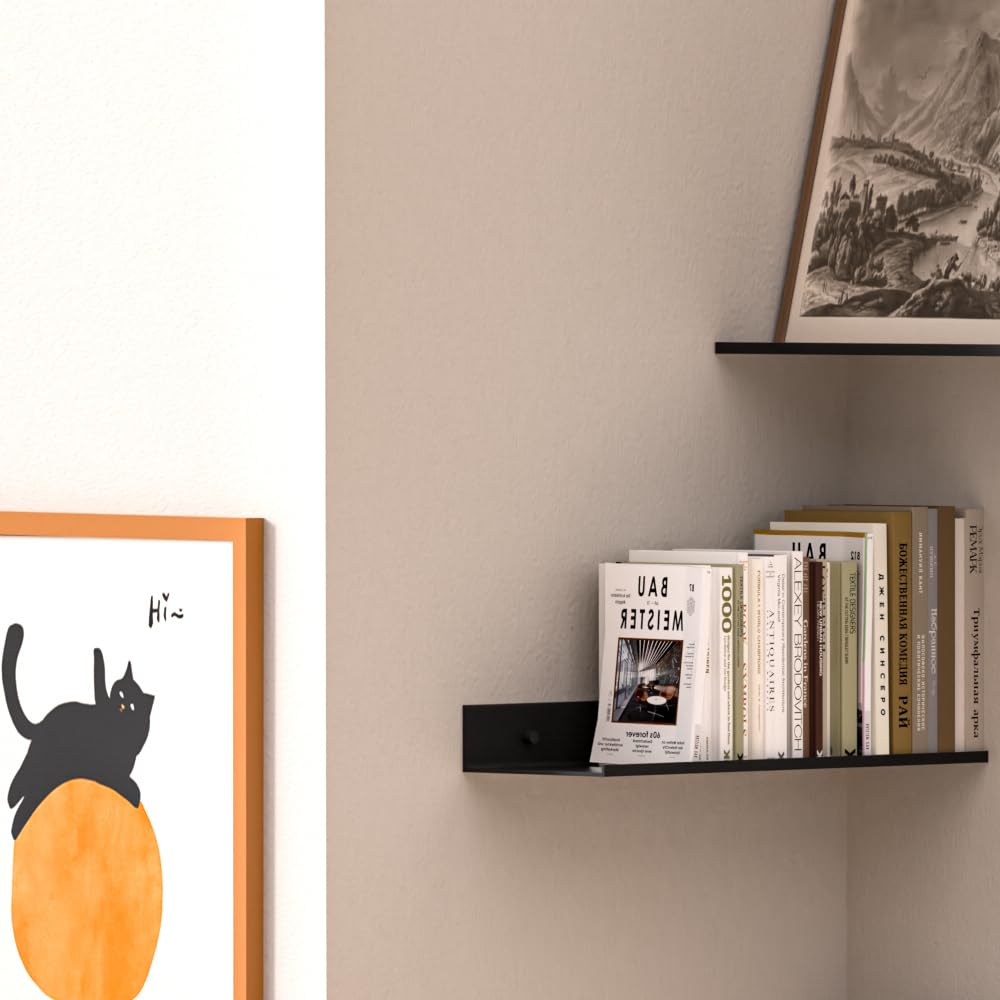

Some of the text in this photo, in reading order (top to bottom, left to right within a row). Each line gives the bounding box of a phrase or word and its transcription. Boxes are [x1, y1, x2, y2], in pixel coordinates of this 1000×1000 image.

[721, 575, 732, 634] 1000
[767, 610, 776, 713] ANTIQUAIRES
[794, 557, 802, 751] ALEXEY BRODOVITCH
[898, 543, 908, 686] БОЖЕСТВЕННАЯ КОМЕДИЯ
[898, 695, 910, 729] РАЙ
[971, 608, 981, 738] Триумфальная арка
